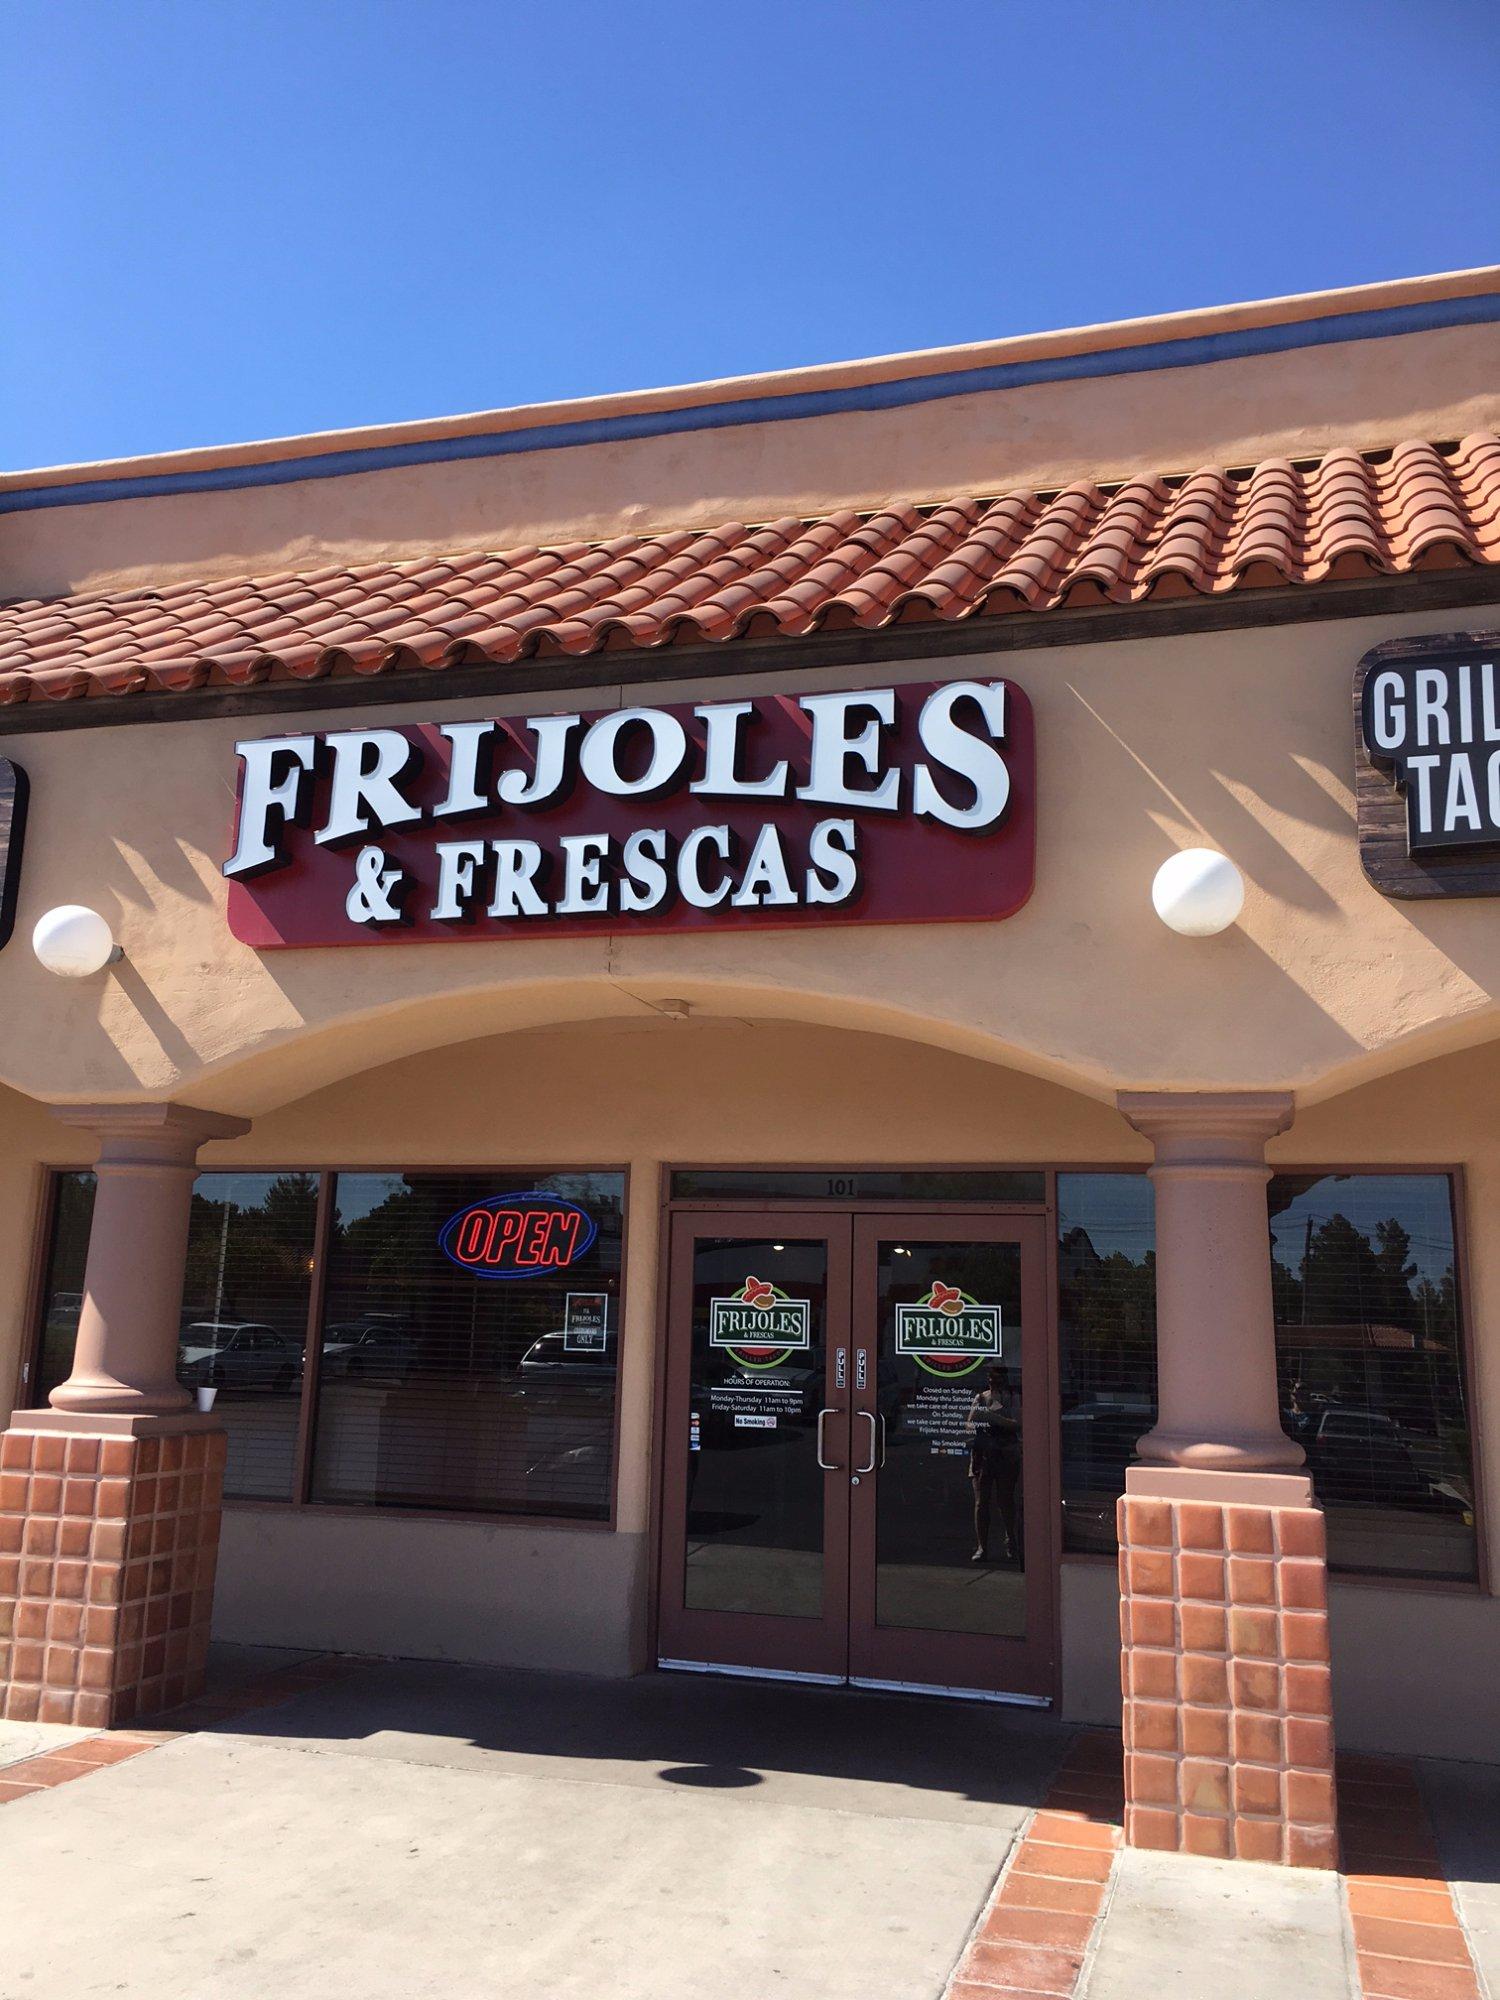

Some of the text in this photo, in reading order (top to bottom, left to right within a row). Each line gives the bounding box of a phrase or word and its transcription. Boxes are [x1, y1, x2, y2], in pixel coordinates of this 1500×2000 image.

[223, 681, 1011, 877] FRIJOLES
[346, 818, 859, 924] & FRESCAS
[827, 1179, 856, 1197] 101
[457, 1210, 581, 1266] OPEN
[718, 1310, 802, 1335] FRIJOLES
[743, 1331, 775, 1339] & FRESCAS
[903, 1317, 993, 1343] FRIJOLES
[755, 1379, 791, 1387] OPERATION:
[923, 1386, 942, 1394] Closed
[951, 1387, 972, 1396] Sunday
[710, 1394, 762, 1404] Monday-Thursday
[789, 1398, 803, 1406] 9pm
[916, 1394, 939, 1403] Monday
[711, 1403, 757, 1412] Friday-Saturday
[759, 1405, 775, 1413] 11am
[784, 1406, 802, 1414] 10pm
[735, 1417, 766, 1427] No Smoking
[919, 1427, 977, 1436] Frijoles Management
[941, 1440, 967, 1448] Smoking
